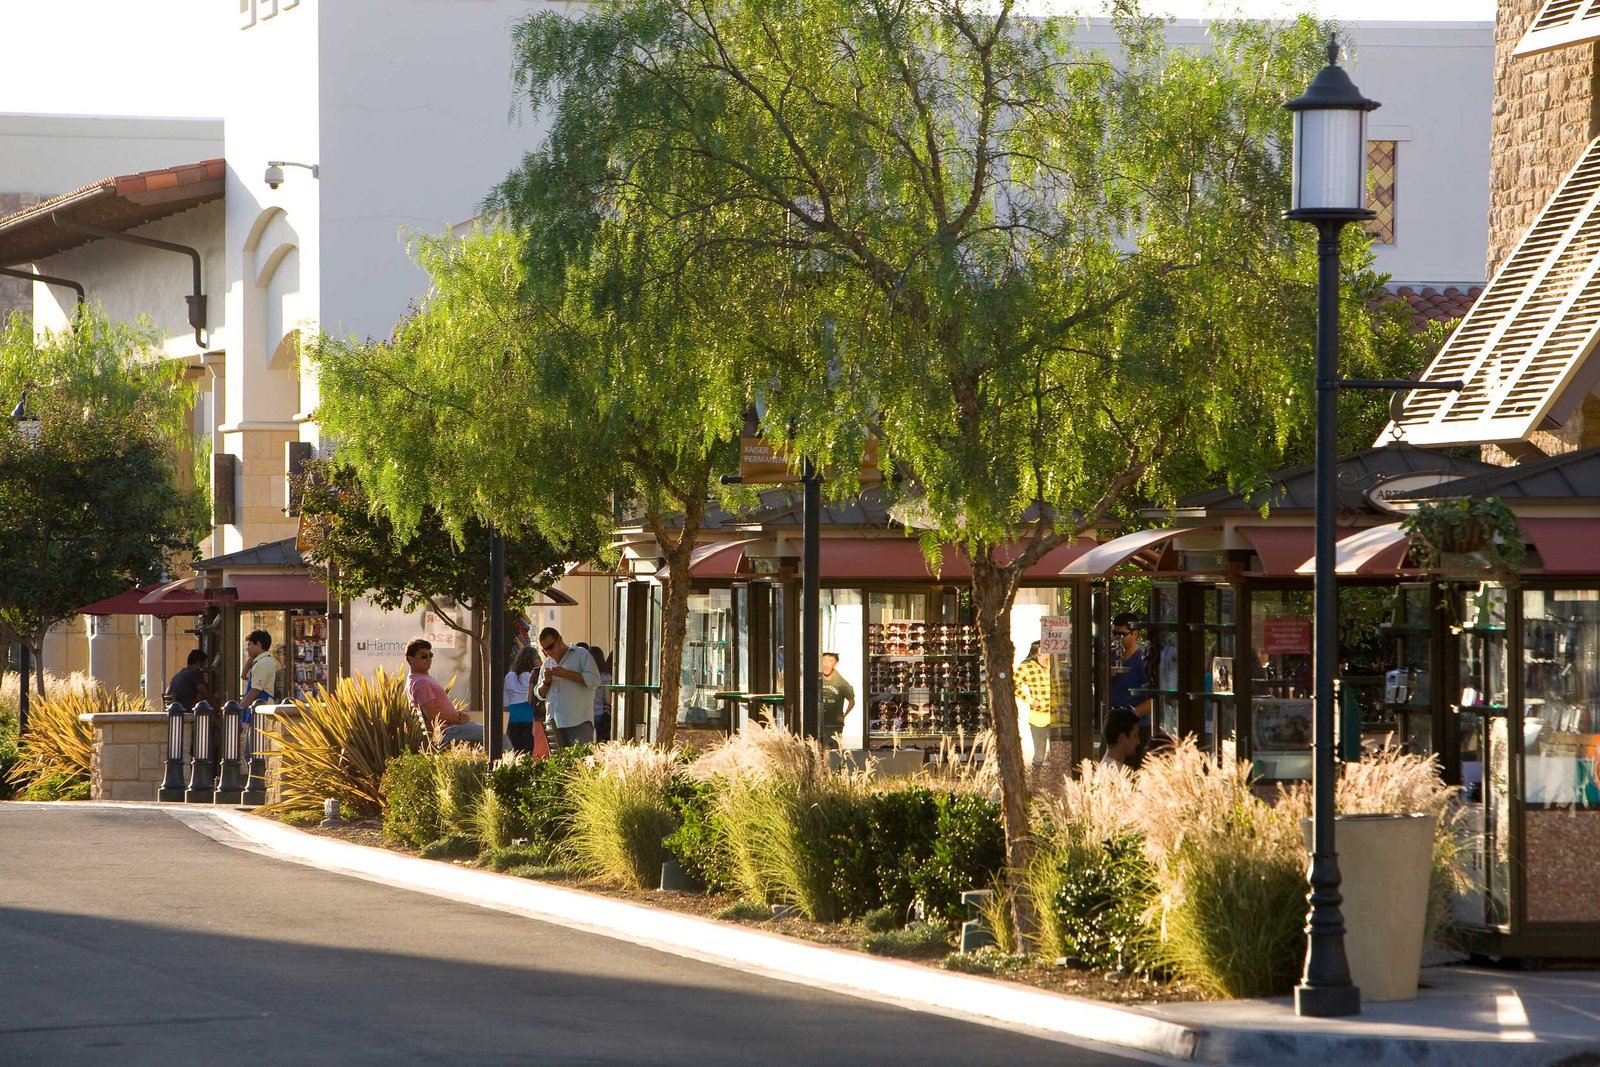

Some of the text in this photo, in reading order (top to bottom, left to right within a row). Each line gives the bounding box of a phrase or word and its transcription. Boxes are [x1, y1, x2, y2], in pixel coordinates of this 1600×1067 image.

[744, 446, 769, 454] KAISER
[1043, 618, 1068, 628] 2 pairs
[1048, 629, 1062, 638] for
[1043, 639, 1068, 651] $22
